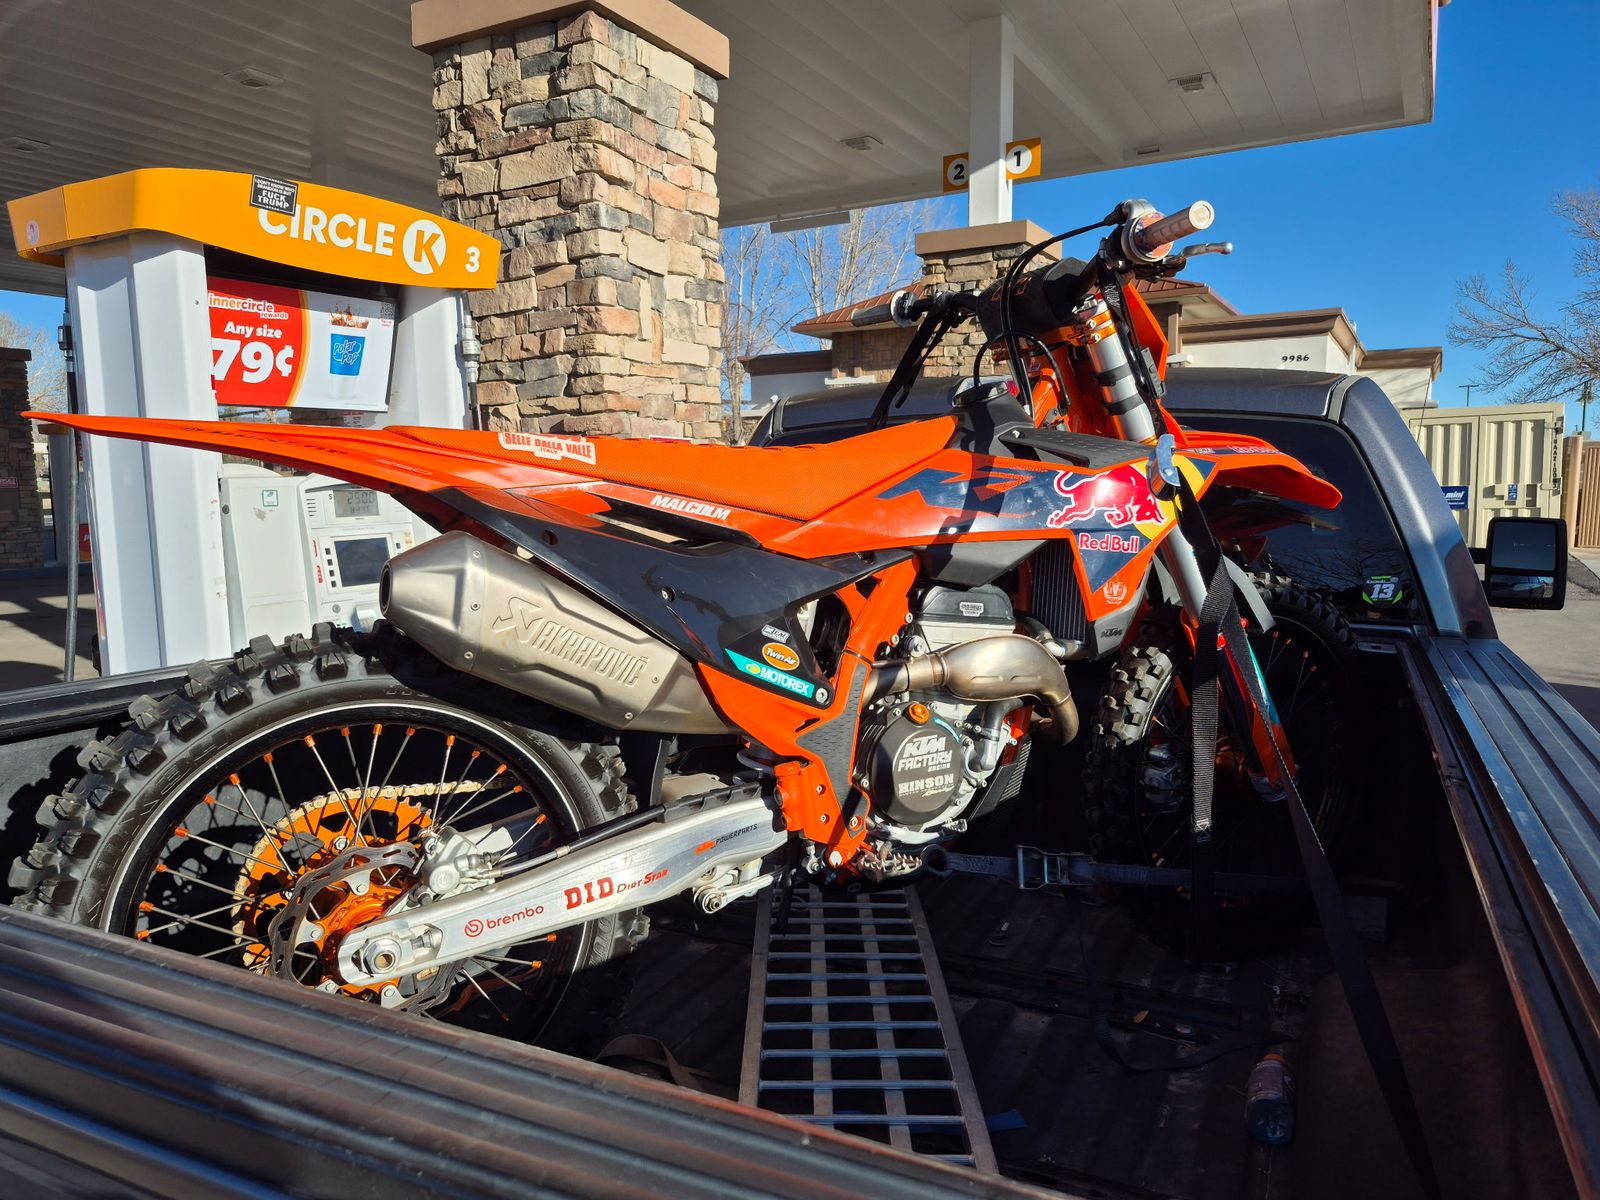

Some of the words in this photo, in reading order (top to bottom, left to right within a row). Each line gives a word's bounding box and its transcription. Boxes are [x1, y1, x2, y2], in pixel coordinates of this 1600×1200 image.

[1013, 150, 1022, 167] 1
[952, 163, 965, 180] 2
[257, 195, 290, 209] TRUMP
[262, 190, 286, 202] FUCK
[258, 204, 396, 257] CIRCLE
[409, 226, 443, 273] K
[464, 245, 481, 273] 3
[209, 293, 274, 313] innercircle
[224, 321, 254, 338] Any
[255, 324, 283, 339] size
[334, 340, 356, 353] Polar
[211, 337, 294, 384] 79¢
[341, 353, 359, 365] Pop
[1281, 354, 1310, 363] 9986
[504, 432, 532, 446] SELLE
[534, 438, 563, 451] DALLA
[565, 443, 592, 459] VALLE
[539, 447, 558, 455] ITALY
[650, 494, 732, 520] MALCOLM
[1079, 532, 1111, 552] Red
[1111, 534, 1140, 554] Bull
[1370, 583, 1396, 599] 13
[766, 647, 785, 661] Twin
[784, 655, 797, 665] Air
[760, 666, 811, 696] MOTOREX
[902, 734, 947, 758] KTM
[897, 750, 953, 772] FACTORY
[898, 773, 954, 795] HINSON
[715, 823, 758, 845] POWERPARTS
[486, 905, 545, 929] brembo
